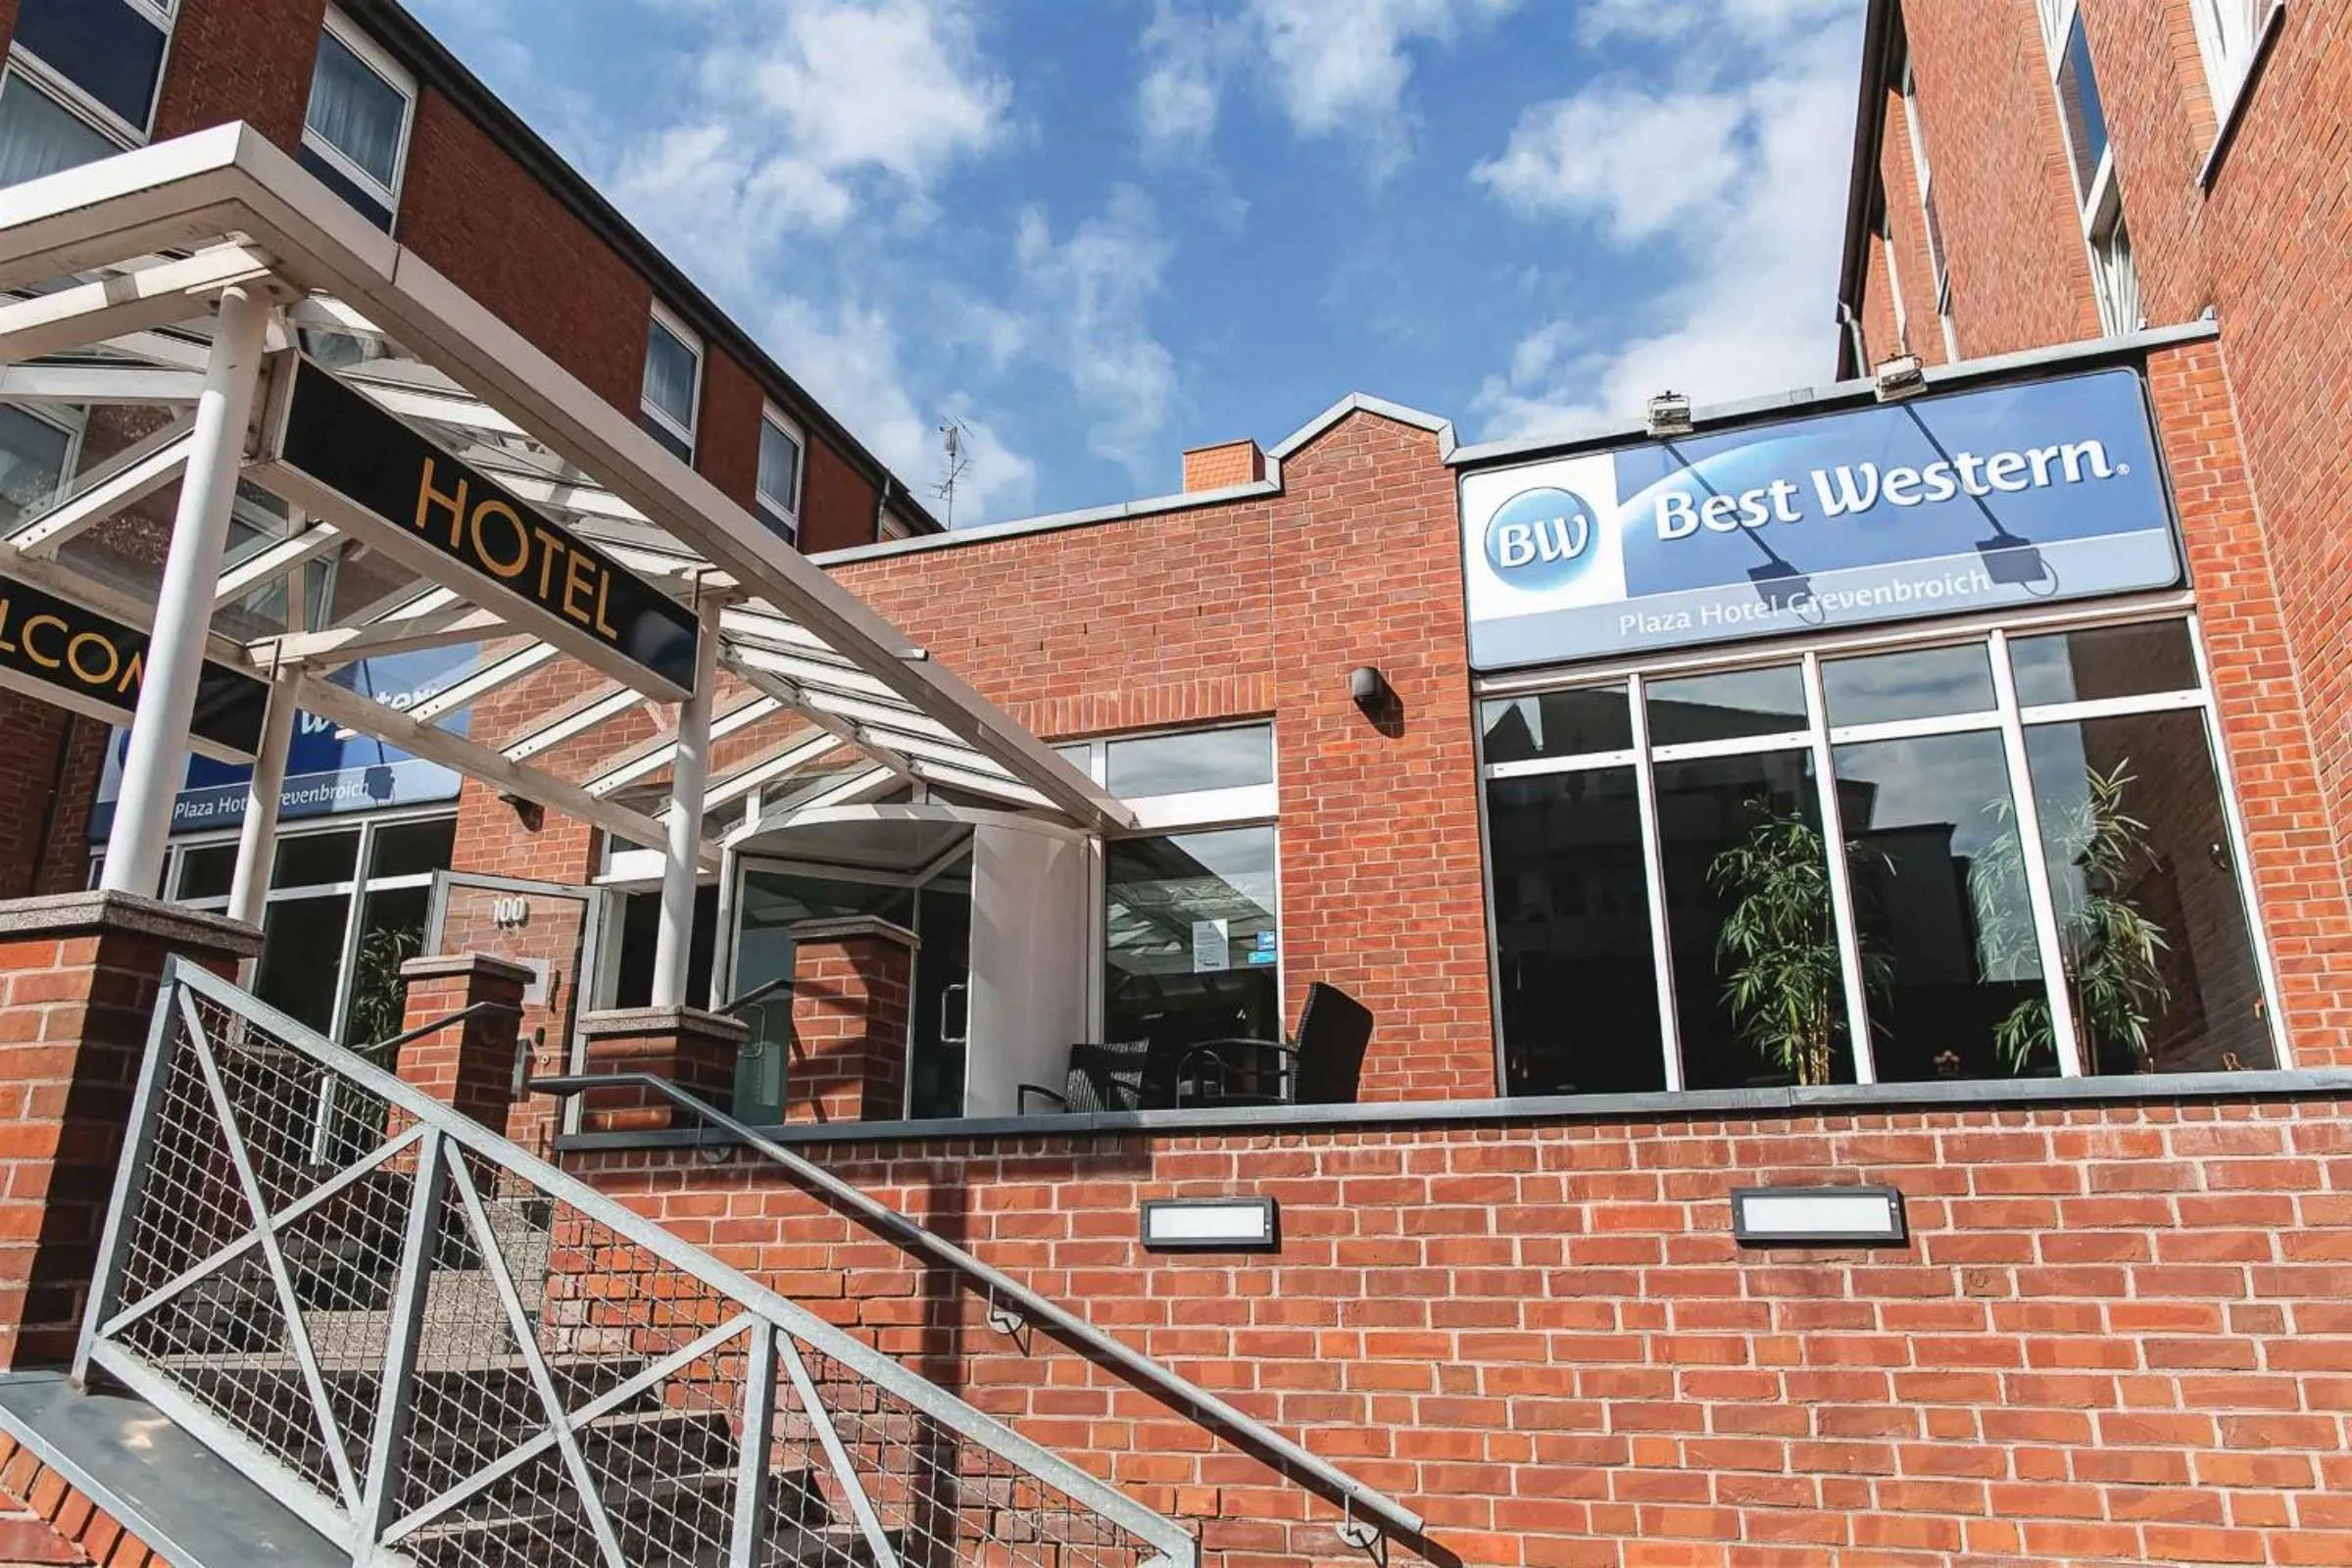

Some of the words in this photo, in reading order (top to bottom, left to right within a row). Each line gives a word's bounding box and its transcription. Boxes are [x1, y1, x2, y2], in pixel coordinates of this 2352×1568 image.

[1653, 479, 1804, 541] Best
[415, 458, 618, 640] HOTEL
[1497, 514, 1591, 568] BW
[1618, 612, 1692, 637] Plaza
[1699, 595, 1779, 626] Hotel
[1787, 569, 1992, 615] Grevenbroich
[173, 801, 215, 819] Plaza
[218, 796, 247, 814] Hot
[280, 780, 369, 806] evenbroich
[493, 898, 526, 923] 100
